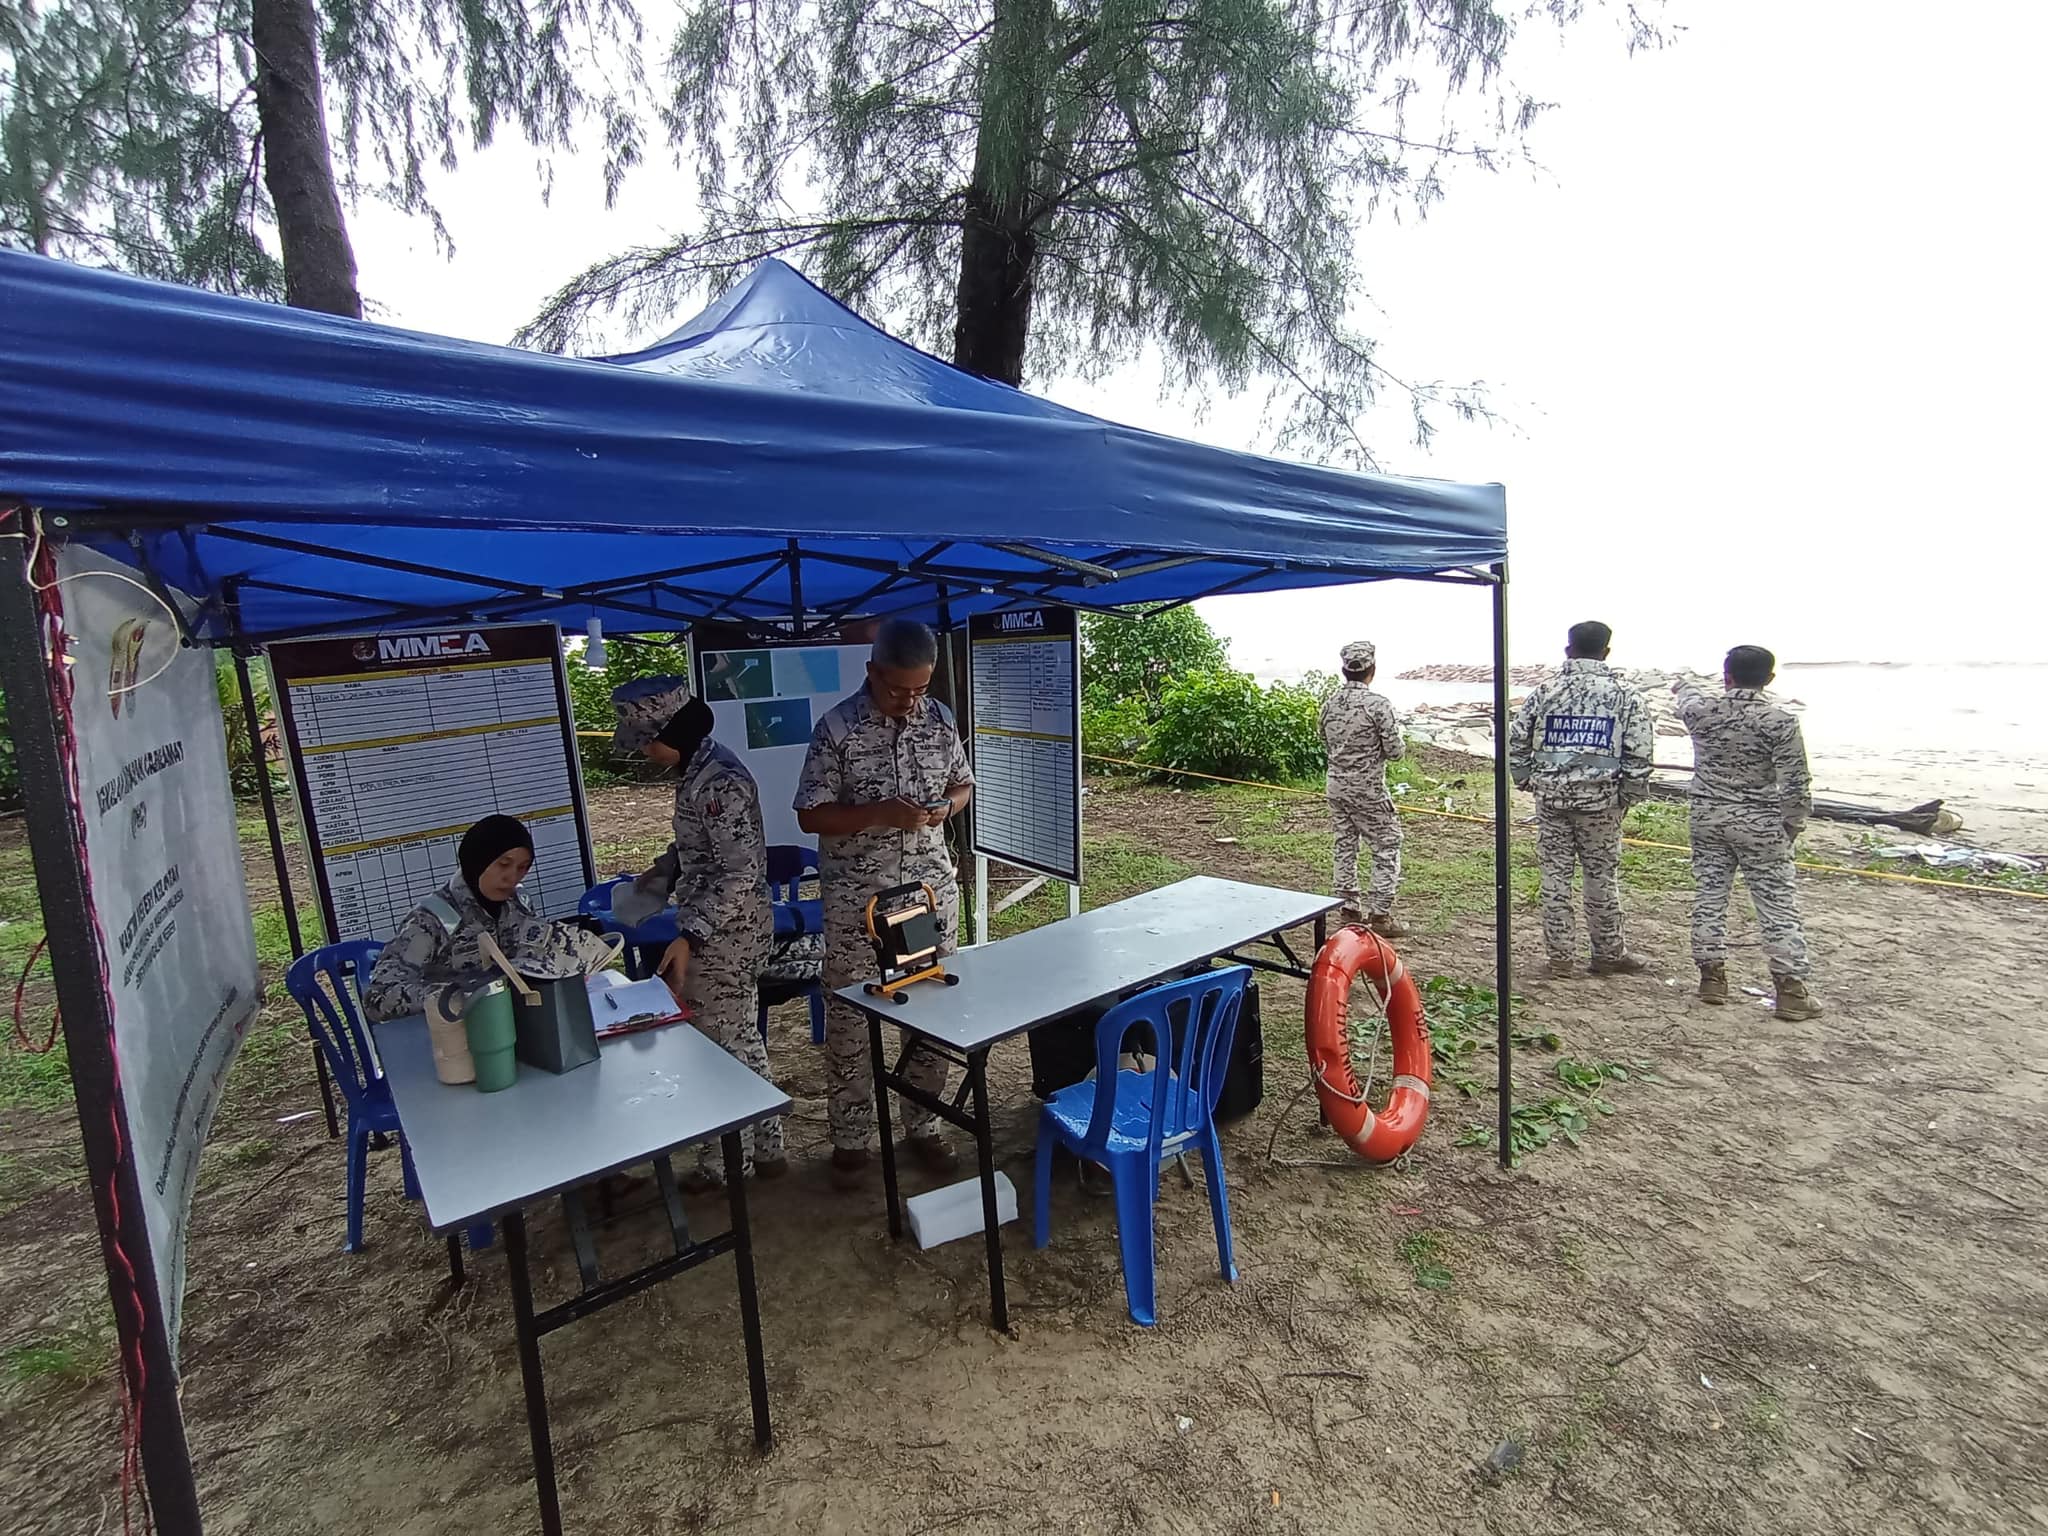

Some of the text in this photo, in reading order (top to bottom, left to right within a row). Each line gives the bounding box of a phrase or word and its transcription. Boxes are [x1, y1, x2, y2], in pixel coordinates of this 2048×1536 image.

[1001, 610, 1044, 630] MMEA
[377, 632, 491, 660] MMEA
[1553, 718, 1607, 732] MARITIM
[1547, 732, 1608, 746] MALAYSIA
